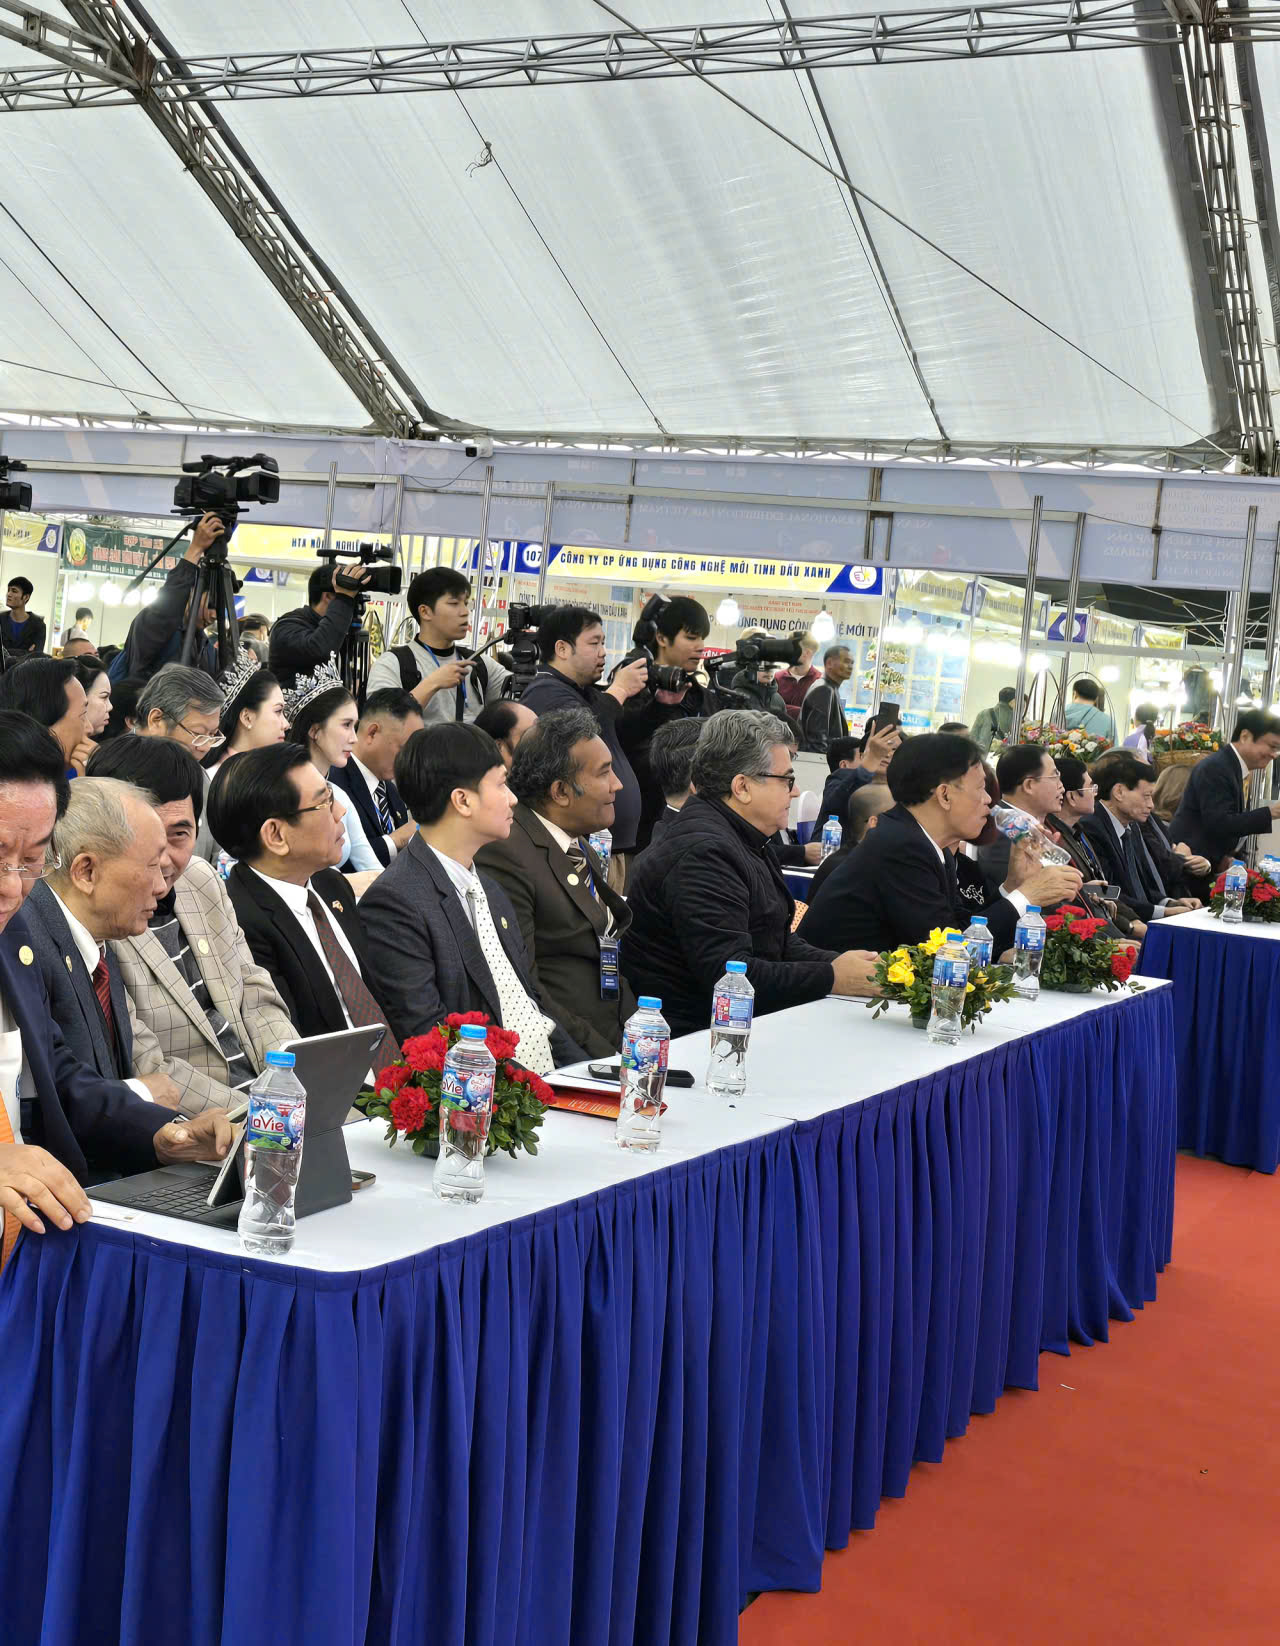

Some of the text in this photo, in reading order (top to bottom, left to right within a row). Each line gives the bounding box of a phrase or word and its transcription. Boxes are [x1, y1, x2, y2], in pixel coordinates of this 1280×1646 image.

[526, 550, 543, 562] 107
[560, 551, 584, 565] CÔNG
[588, 554, 599, 565] TY
[603, 555, 615, 566] CP
[619, 553, 638, 568] ỨNG
[642, 557, 667, 571] DỤNG
[671, 557, 696, 571] CÔNG
[700, 560, 726, 575] NGHỆ
[730, 560, 749, 574] MỚI
[753, 563, 776, 576] TINH
[804, 566, 831, 579] XANH
[846, 622, 866, 636] MỚI
